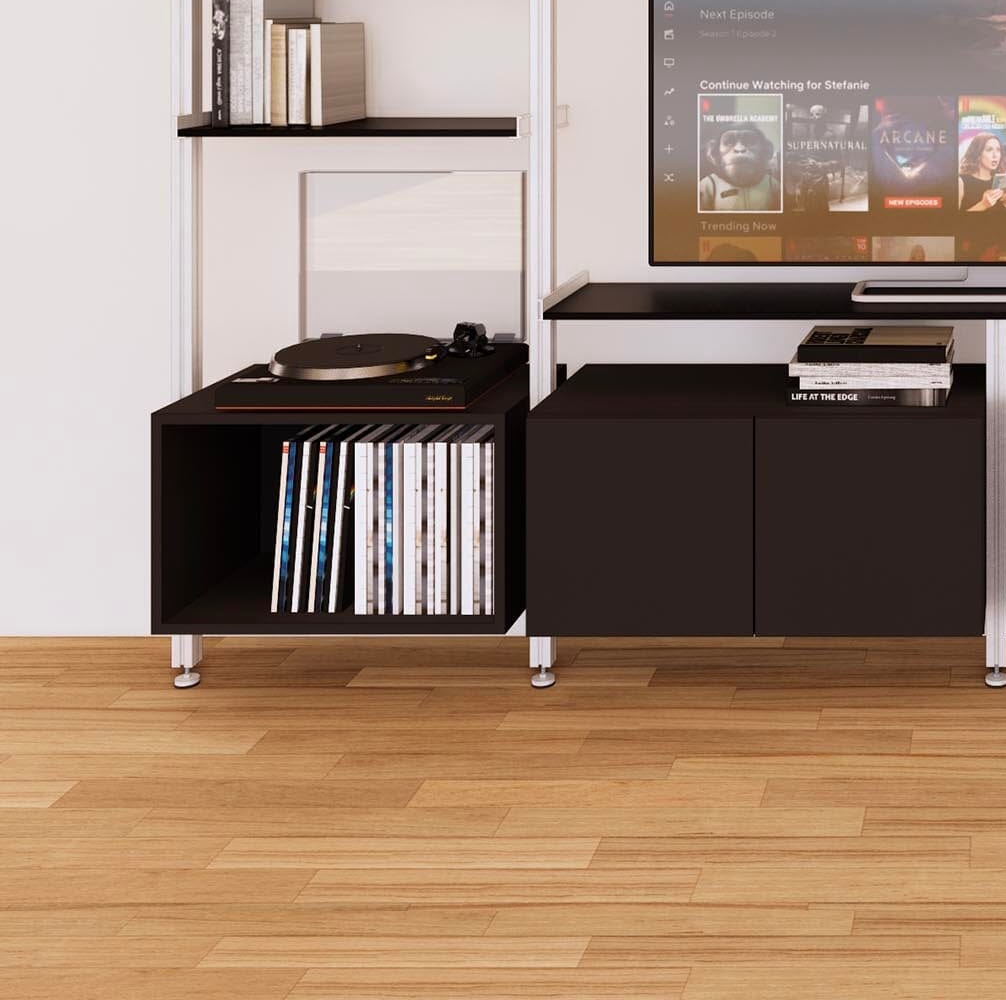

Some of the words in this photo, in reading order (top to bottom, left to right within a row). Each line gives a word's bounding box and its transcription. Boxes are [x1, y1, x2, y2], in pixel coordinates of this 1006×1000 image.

[700, 9, 726, 19] Next
[730, 9, 775, 21] Episode
[700, 80, 750, 90] Continue
[752, 80, 804, 92] Watching
[806, 80, 822, 90] for
[824, 80, 870, 90] Stefanie
[879, 130, 948, 144] ARCANE
[786, 140, 867, 150] SUPERNATURAL
[700, 221, 750, 232] Trending
[752, 221, 777, 231] Now
